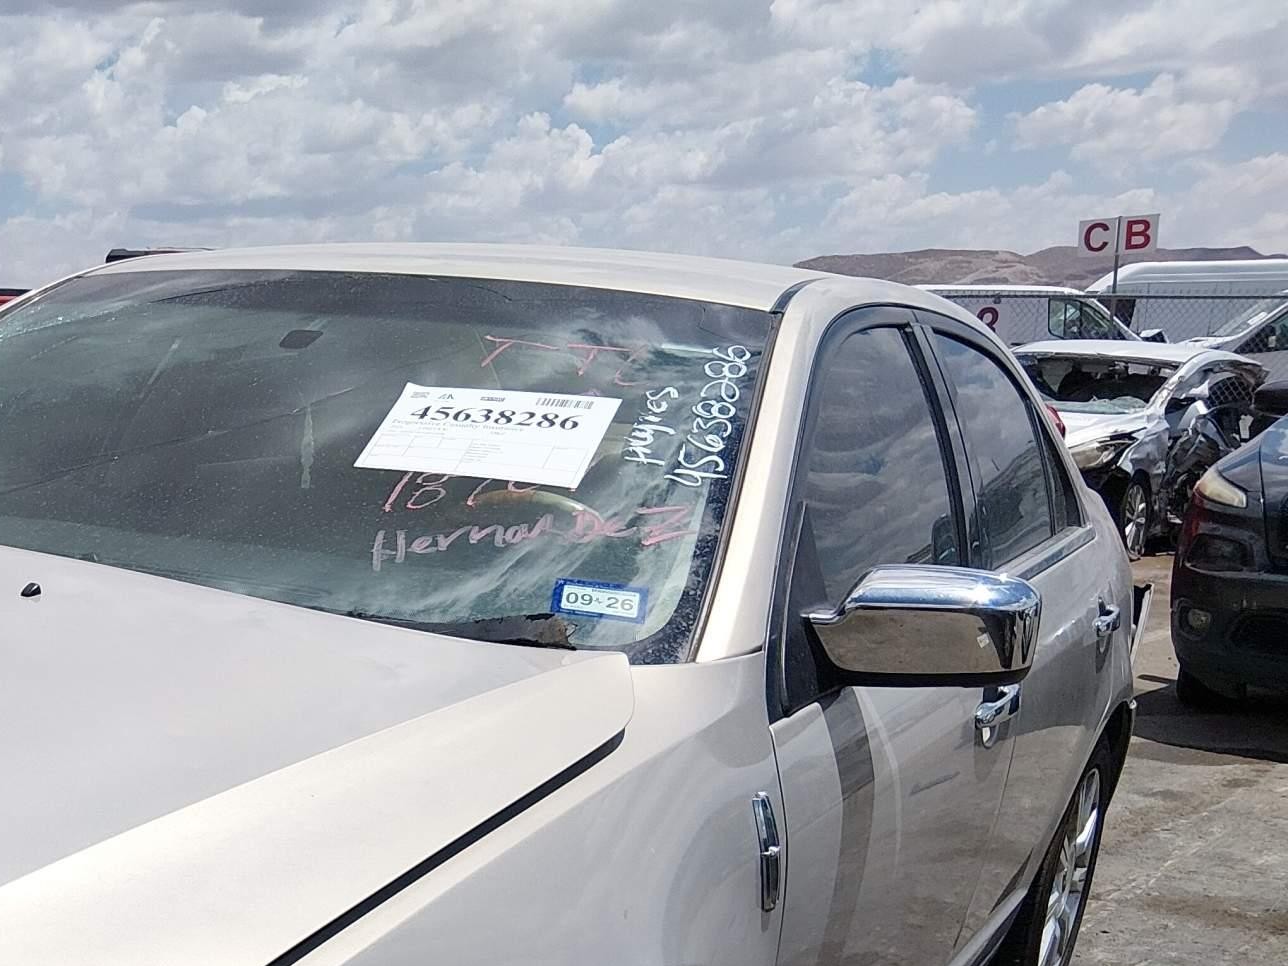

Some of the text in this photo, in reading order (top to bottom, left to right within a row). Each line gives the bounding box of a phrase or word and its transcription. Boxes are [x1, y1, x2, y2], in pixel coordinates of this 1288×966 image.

[1084, 219, 1151, 252] C B
[410, 404, 583, 431] 45638286
[664, 345, 751, 487] 45638286
[565, 592, 593, 606] 09
[606, 596, 634, 611] 26
